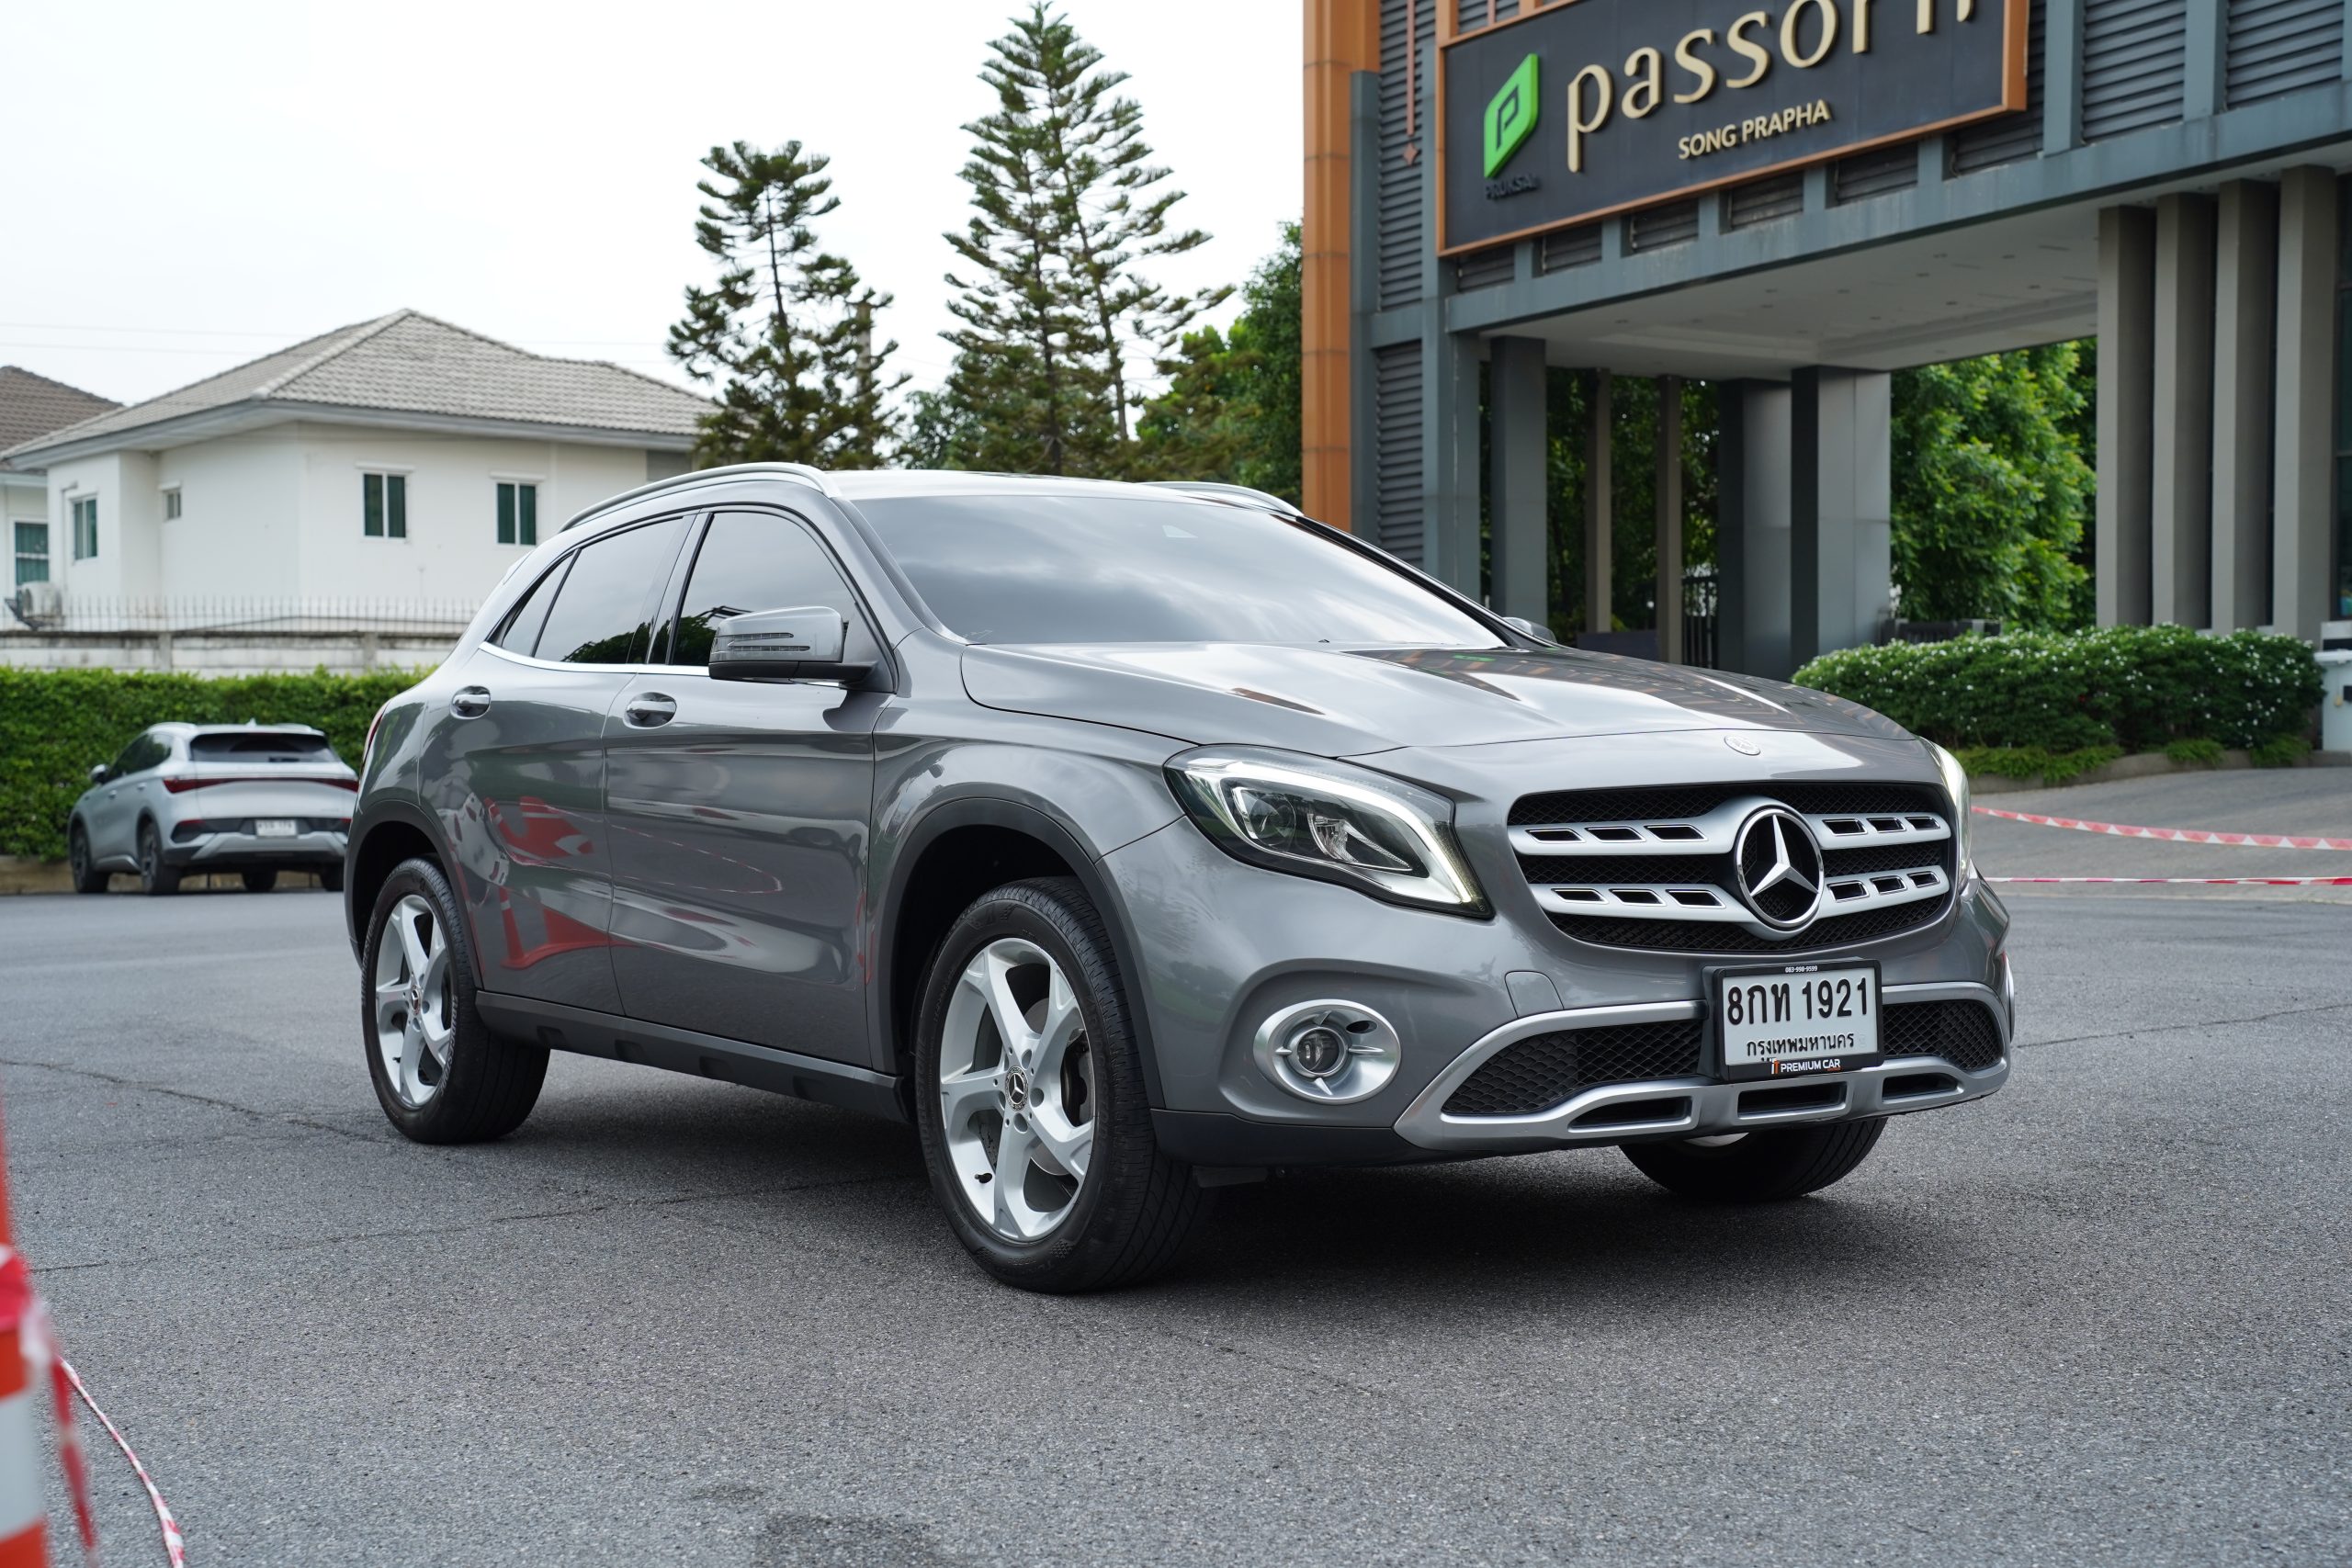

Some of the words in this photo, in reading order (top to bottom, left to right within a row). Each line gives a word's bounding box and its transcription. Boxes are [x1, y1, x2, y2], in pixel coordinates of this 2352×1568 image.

[1679, 130, 1736, 160] SONG
[1742, 99, 1831, 141] PRAPHA
[1727, 983, 1792, 1025] 8กท
[1802, 977, 1867, 1019] 1921
[1747, 1033, 1854, 1060] กรุงเทพมหานคร
[1781, 1060, 1822, 1073] PREMIUM
[1822, 1058, 1841, 1069] CAR
